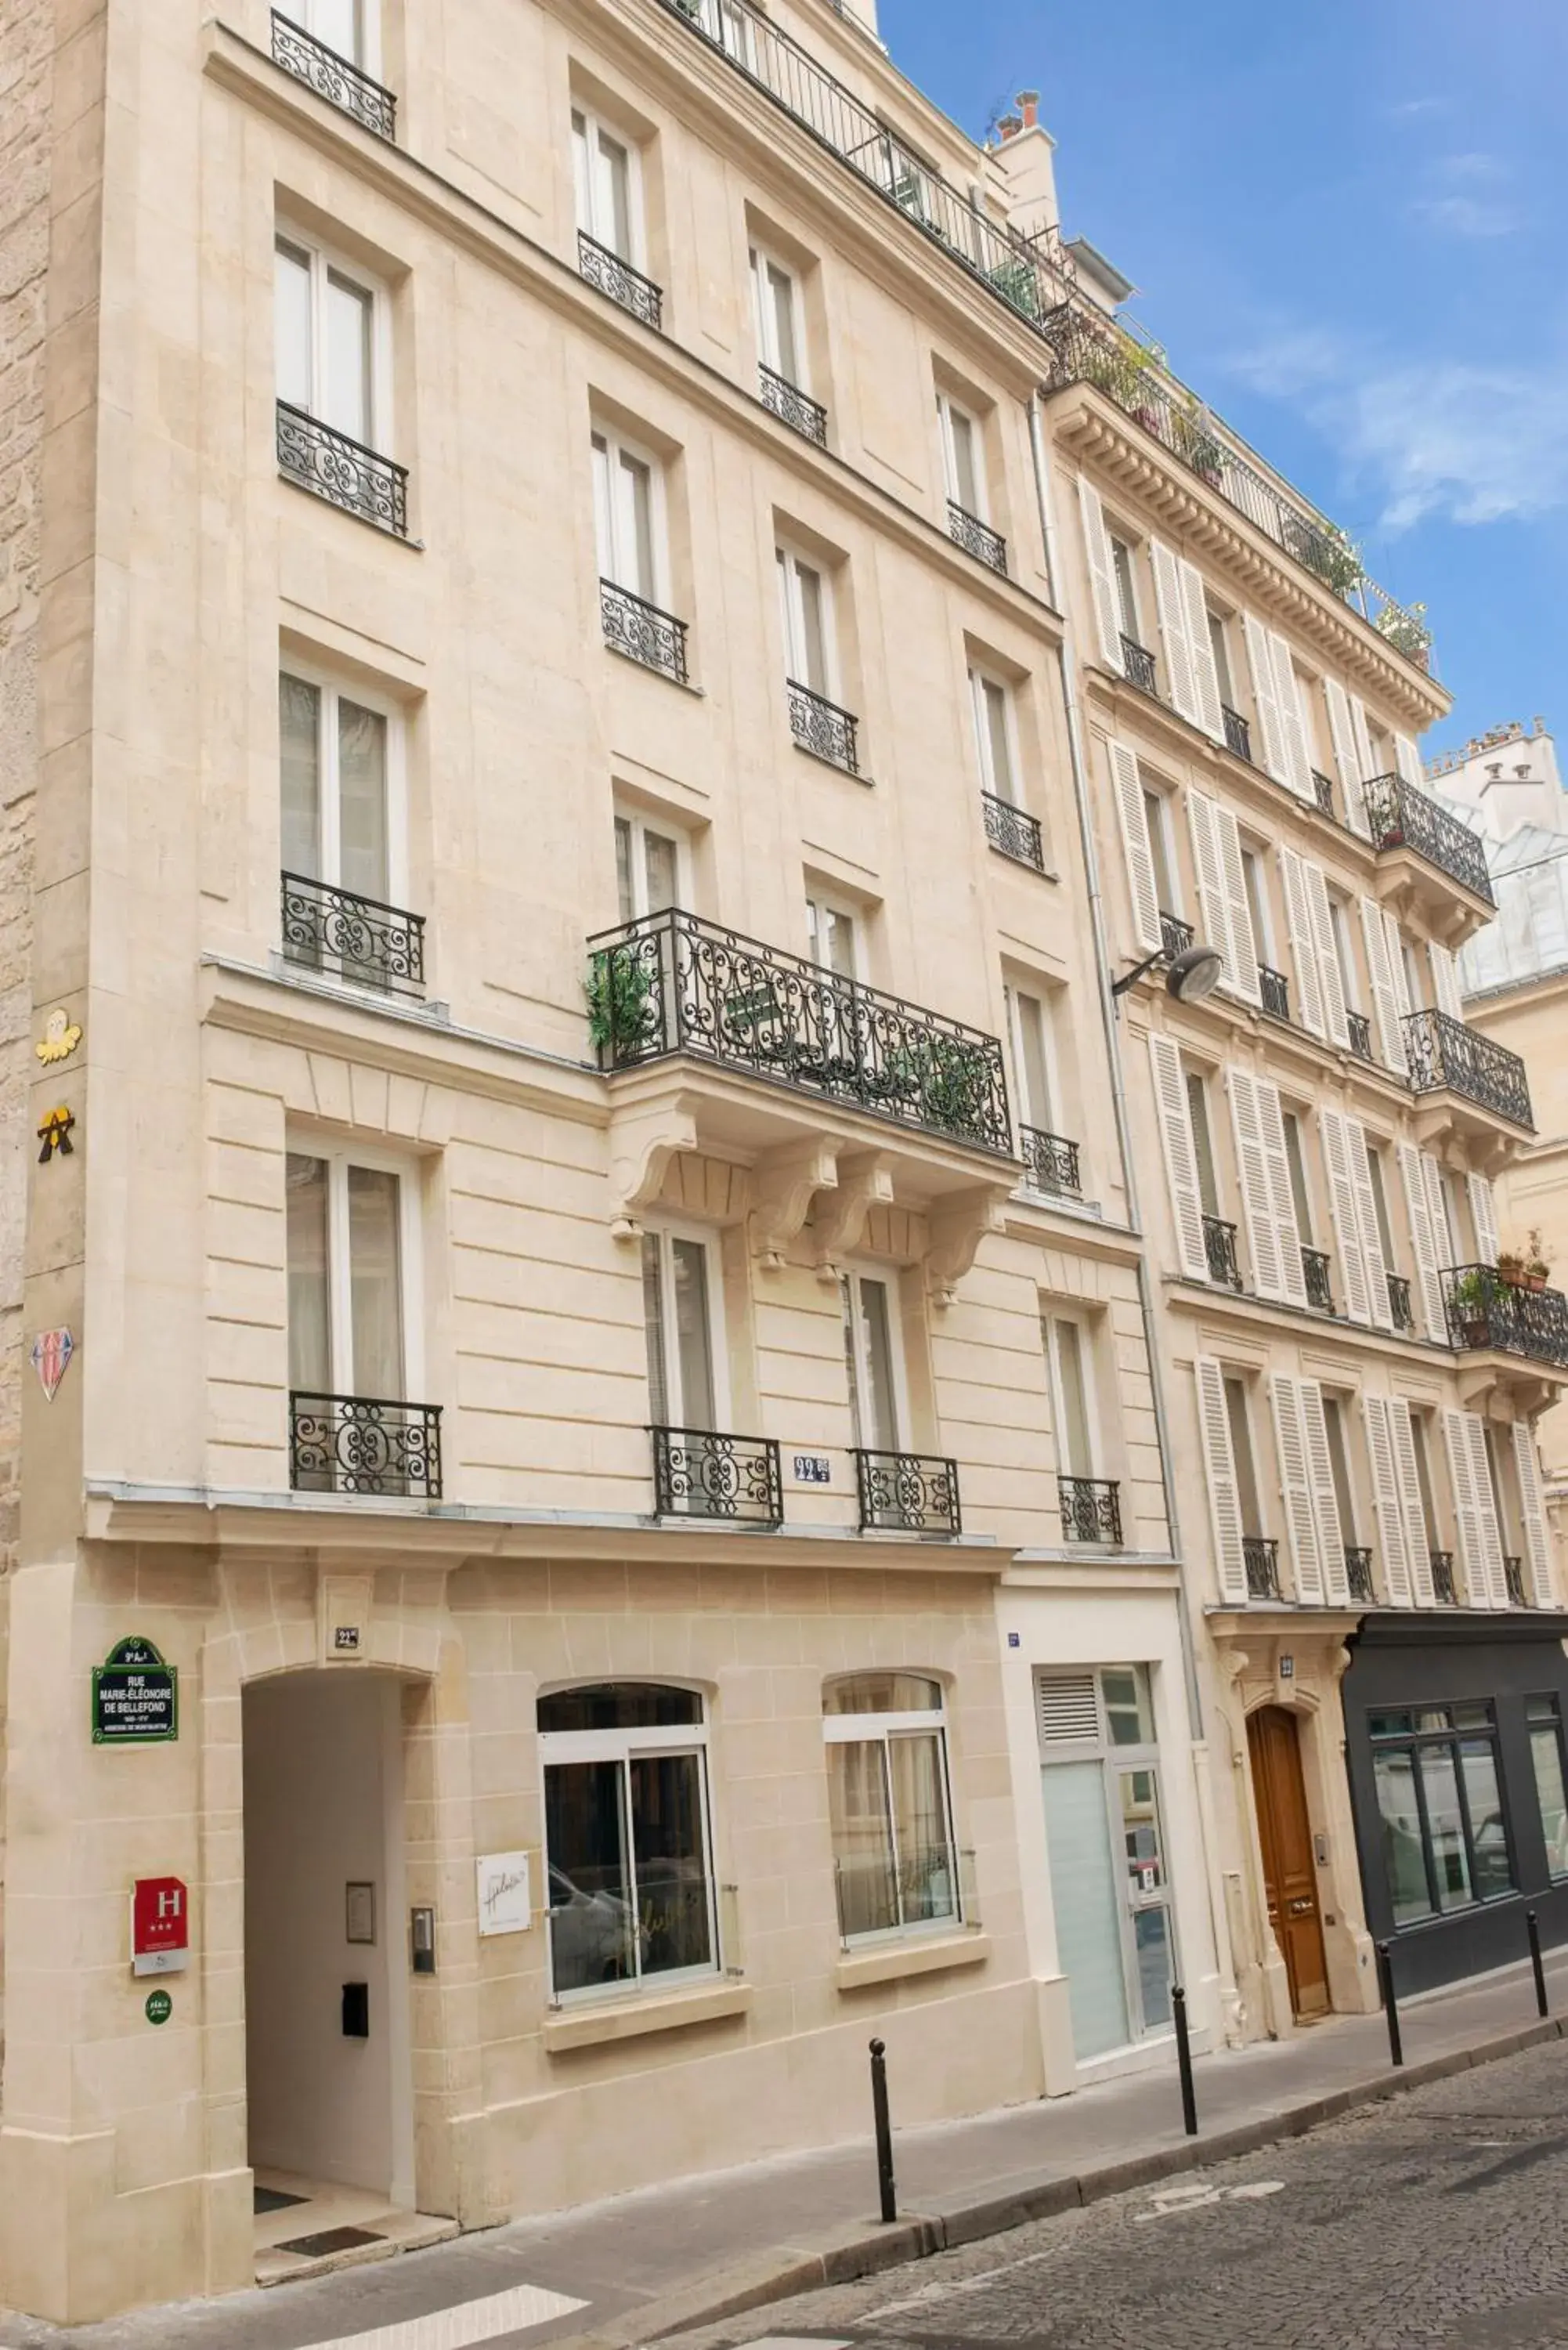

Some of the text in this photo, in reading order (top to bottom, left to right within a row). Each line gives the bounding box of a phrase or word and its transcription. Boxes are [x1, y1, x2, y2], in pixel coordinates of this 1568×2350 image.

[797, 1458, 814, 1480] 22
[128, 1676, 145, 1687] RUE
[99, 1687, 172, 1700] MARIE-ÉLÉONORE
[104, 1701, 166, 1713] DE BELLEFOND
[158, 1889, 181, 1918] H
